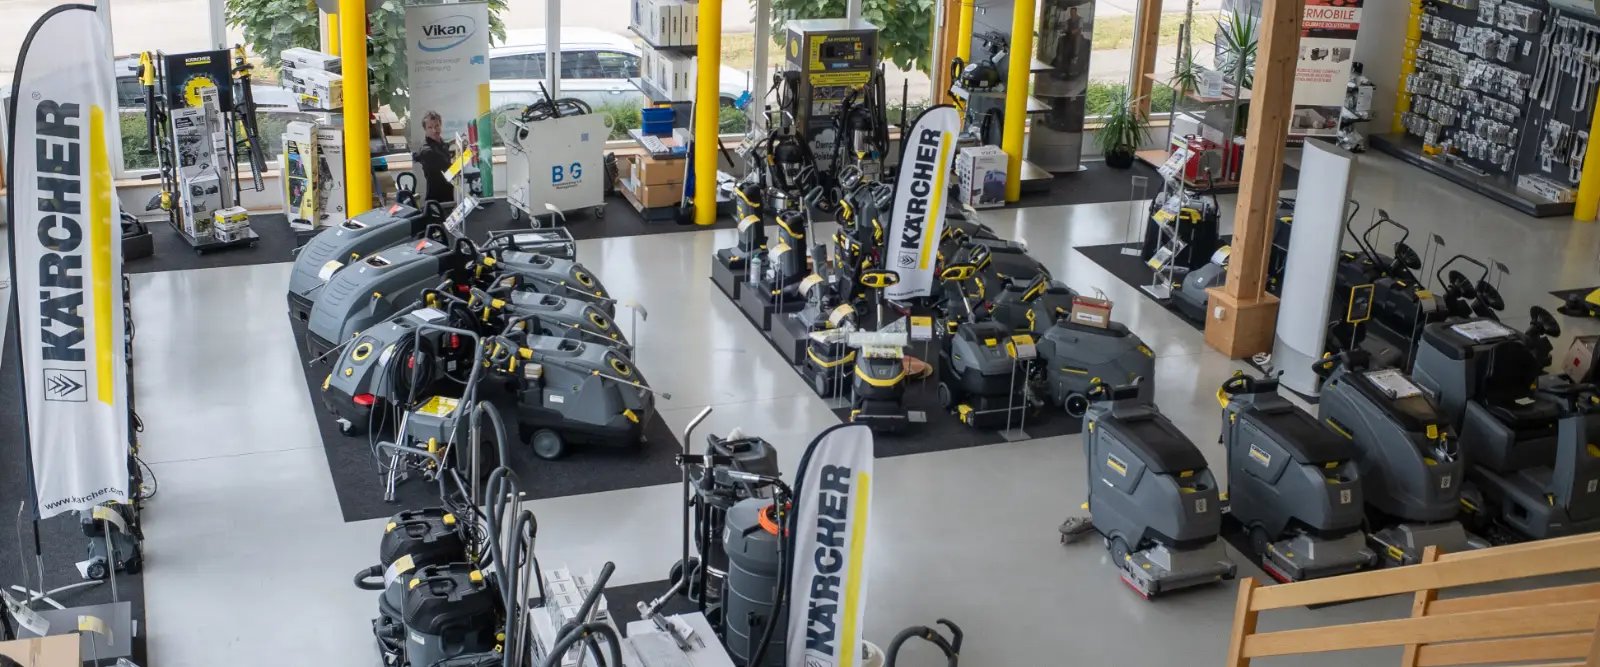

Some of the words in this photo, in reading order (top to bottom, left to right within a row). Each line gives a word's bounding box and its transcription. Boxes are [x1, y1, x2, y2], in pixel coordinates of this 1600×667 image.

[422, 25, 466, 36] Vikan
[36, 99, 86, 362] KÄRCHER
[901, 128, 941, 249] KÄRCHER
[806, 464, 851, 657] KÄRCHER
